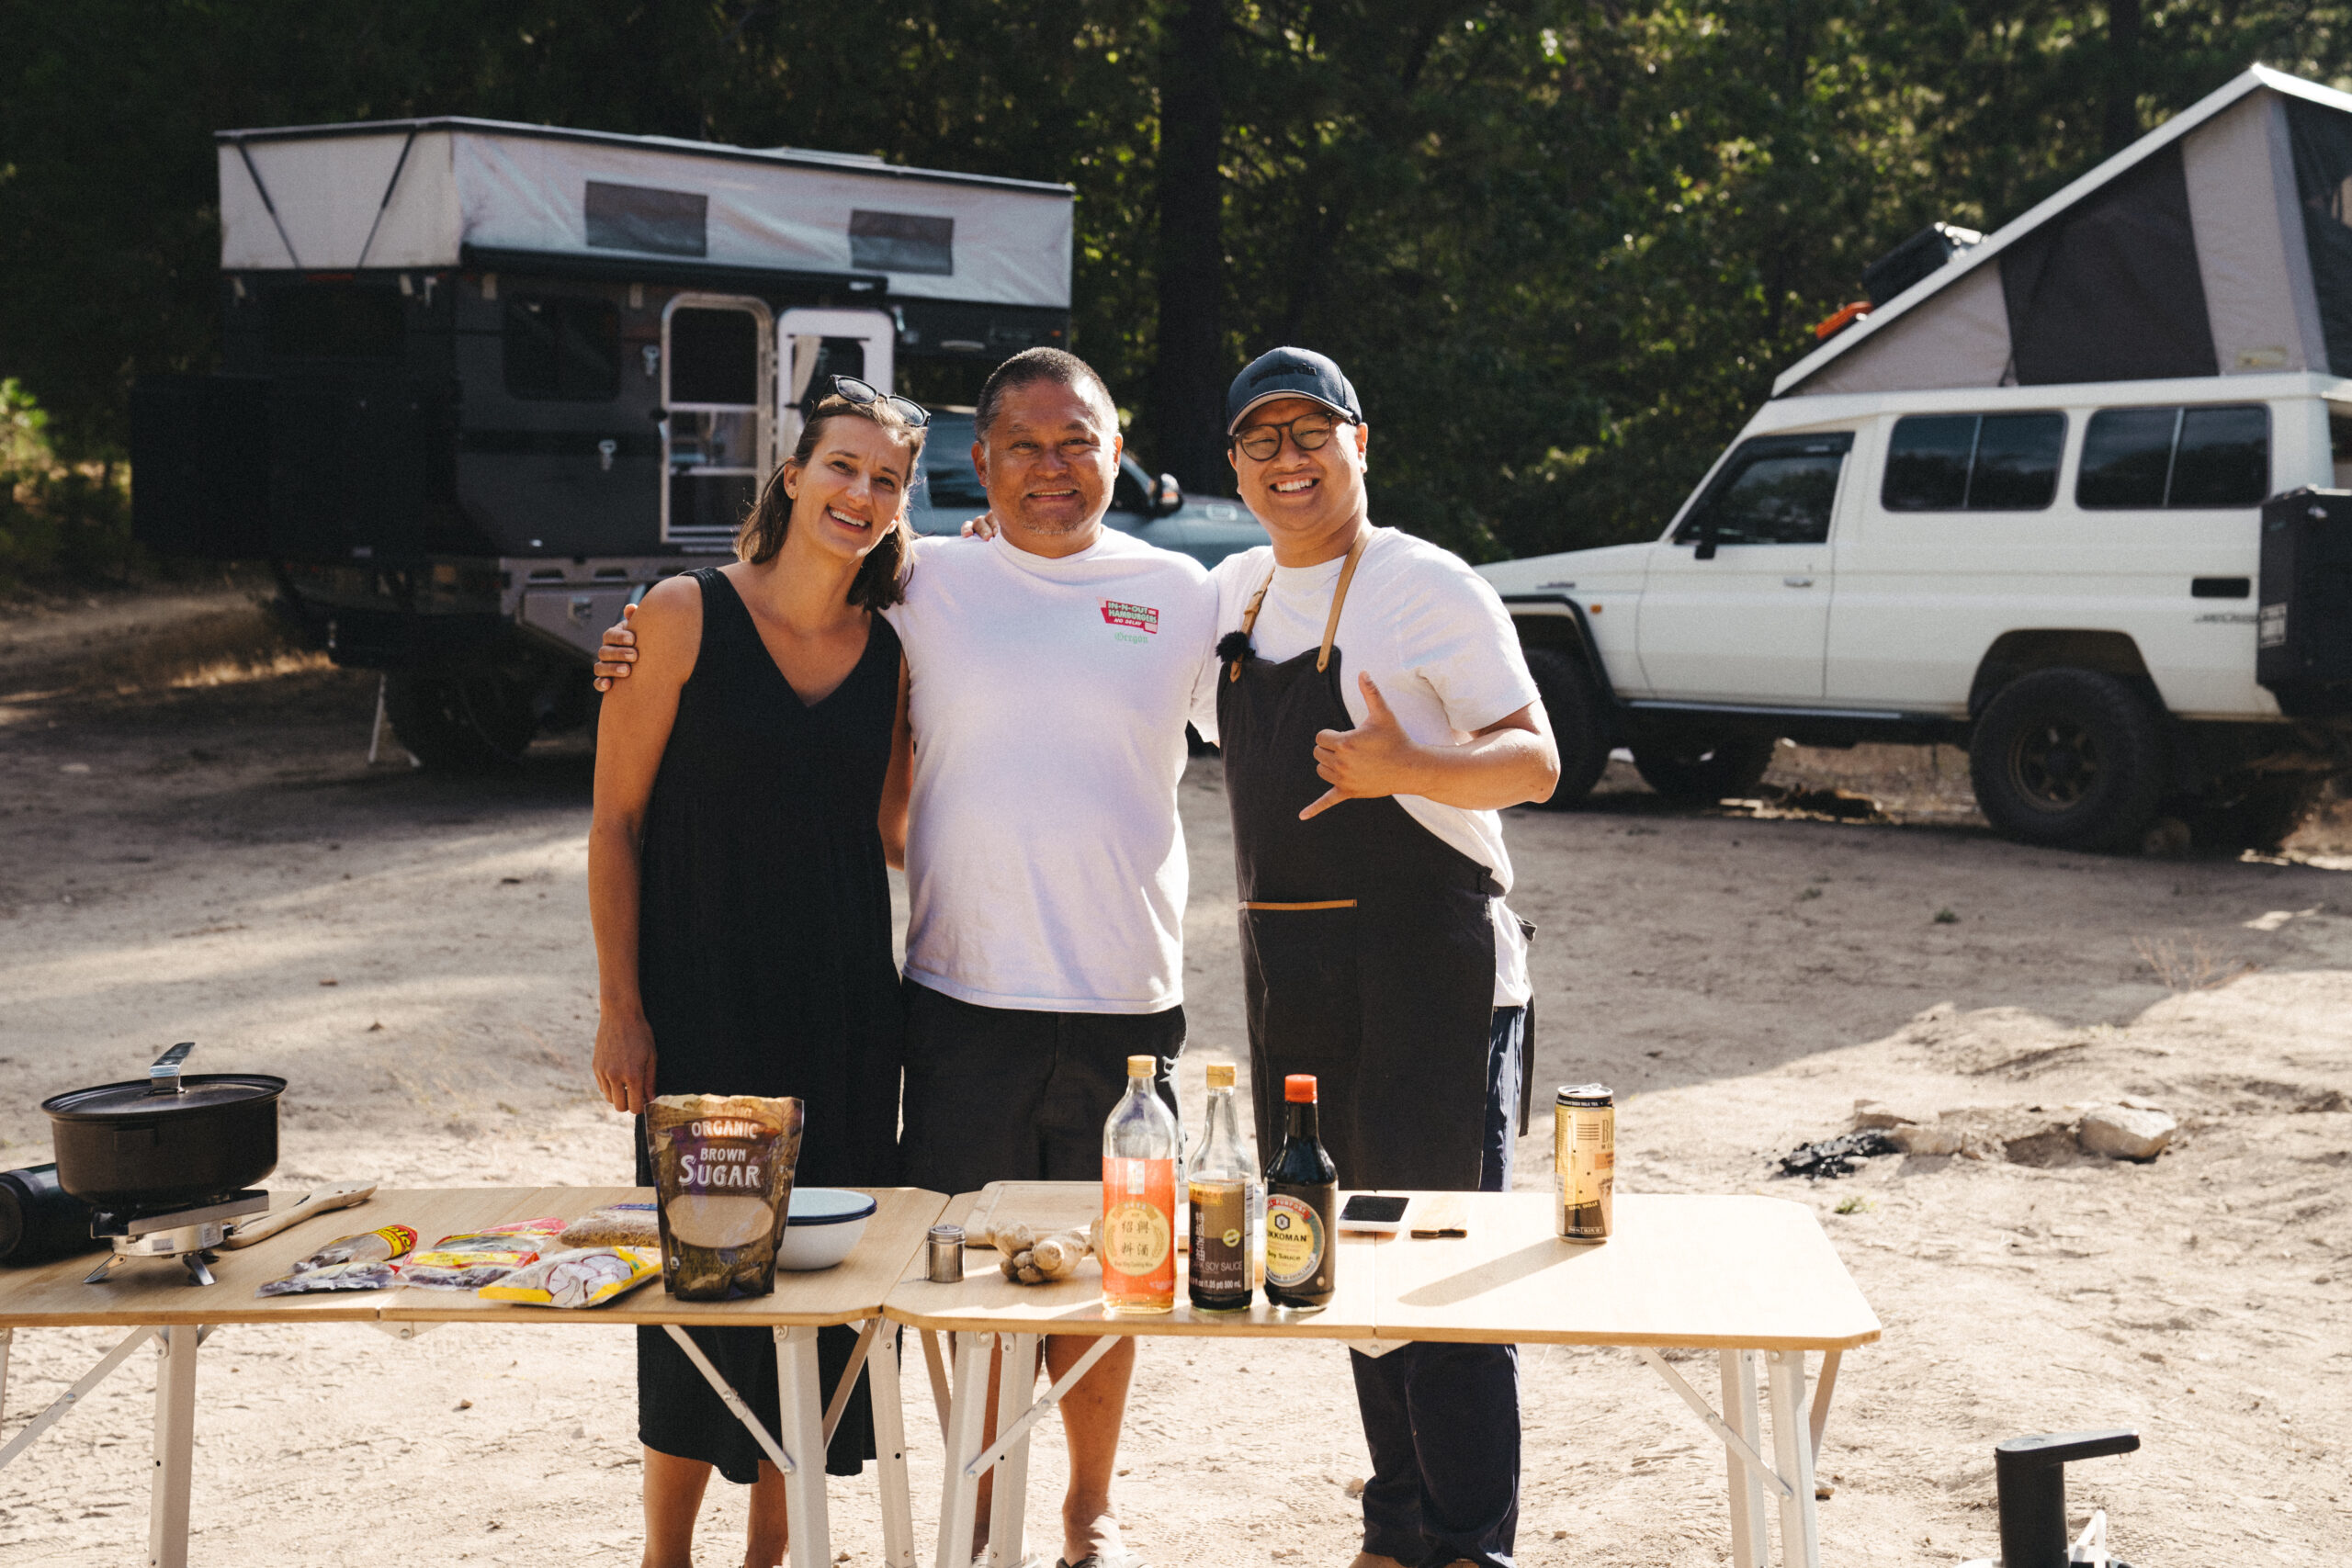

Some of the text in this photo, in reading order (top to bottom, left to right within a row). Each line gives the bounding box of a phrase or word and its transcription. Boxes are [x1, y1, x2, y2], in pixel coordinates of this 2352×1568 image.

[1108, 603, 1148, 613] IN-N-OUT
[1109, 610, 1157, 623] HAMBURGERS
[691, 1120, 759, 1140] ORGANIC
[700, 1147, 747, 1162] BROWN
[678, 1154, 761, 1188] SUGAR
[1204, 1261, 1219, 1271] SOY
[1220, 1260, 1242, 1272] SAUCE
